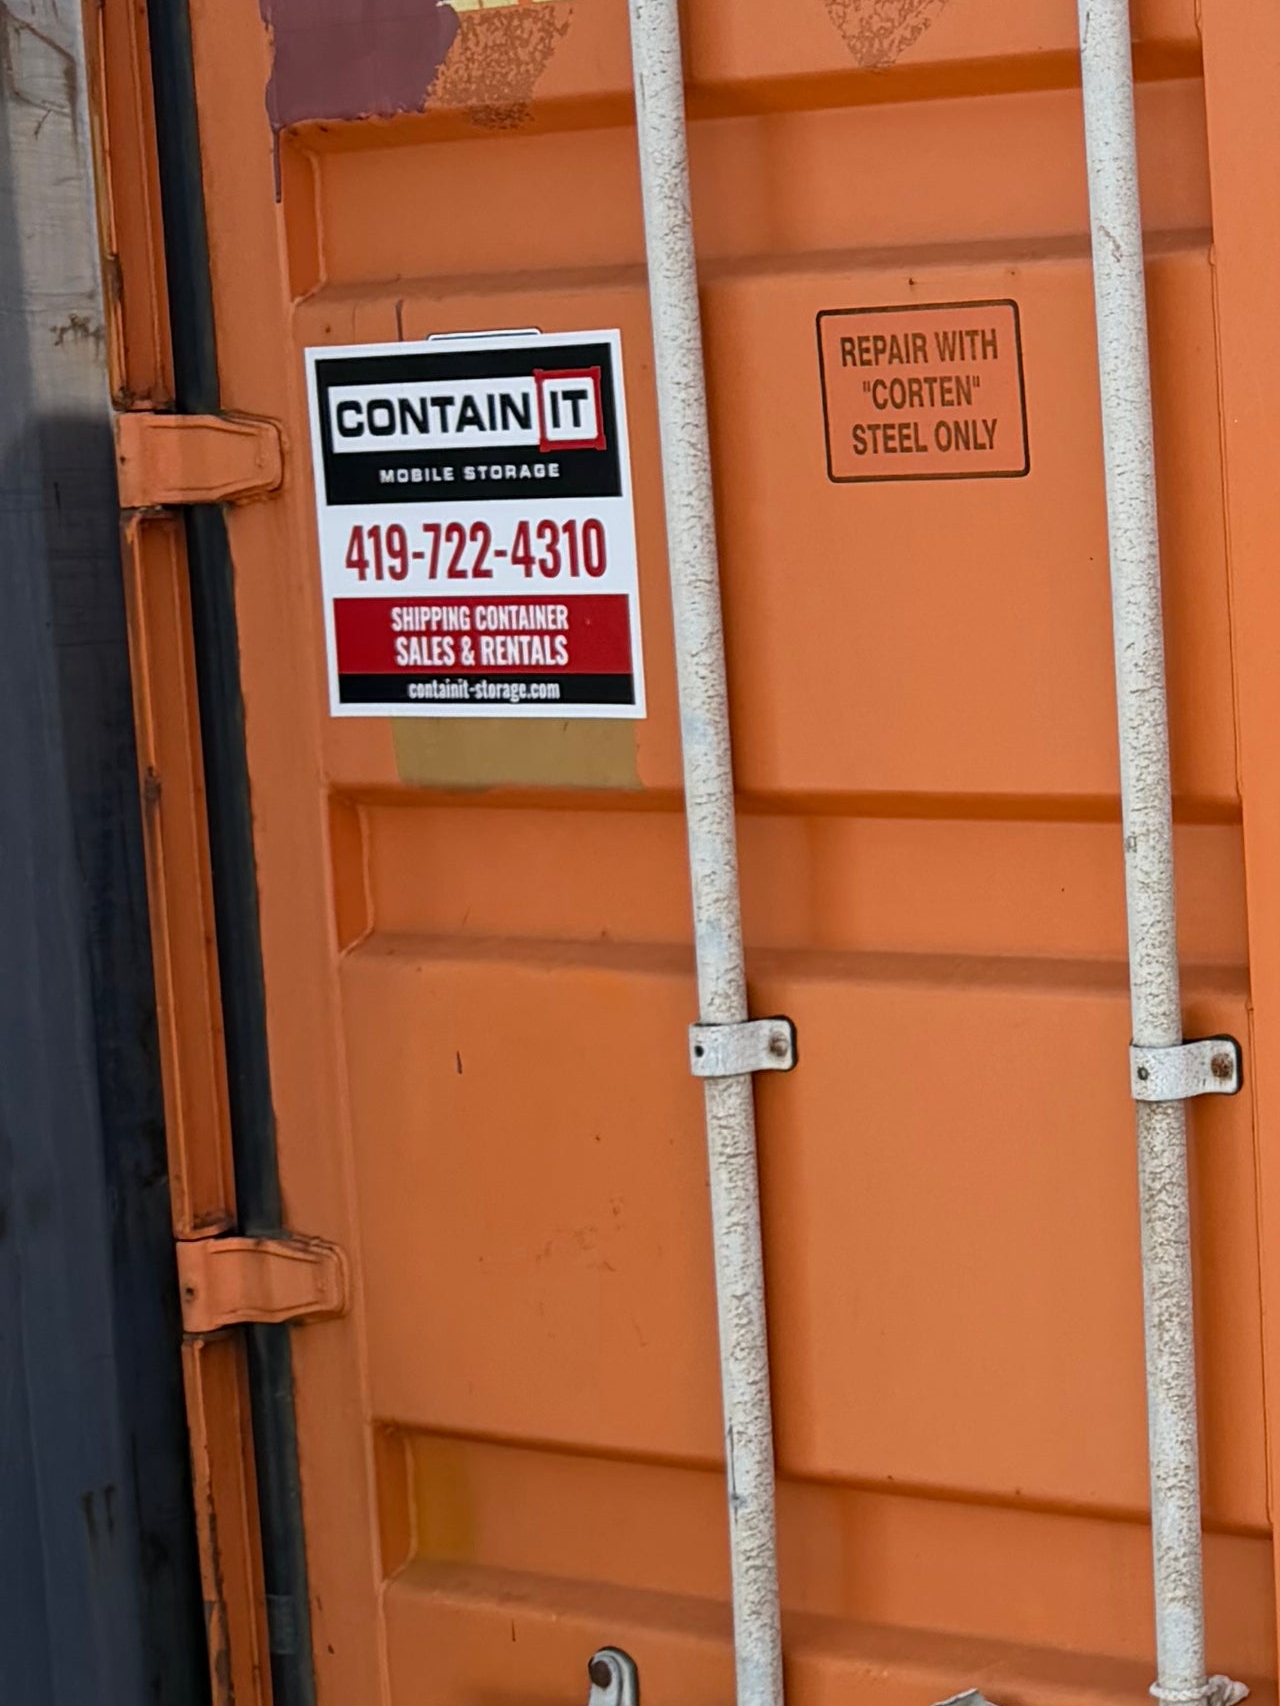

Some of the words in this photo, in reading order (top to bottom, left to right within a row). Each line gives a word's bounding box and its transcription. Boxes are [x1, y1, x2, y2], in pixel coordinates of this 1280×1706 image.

[840, 332, 929, 367] REPAIR
[934, 328, 999, 362] WITH
[862, 375, 981, 410] "CORTEN"
[852, 421, 929, 456] STEEL
[934, 418, 998, 452] ONLY
[379, 467, 455, 484] MOBILE
[463, 463, 560, 481] STORAGE
[344, 517, 608, 582] 419-722-4310
[391, 606, 470, 633] SHIPPING
[474, 604, 569, 631] CONTAINER
[395, 636, 455, 667] SALES
[461, 636, 475, 666] &
[480, 634, 568, 665] RENTALS
[407, 678, 560, 704] containit-storage.com
